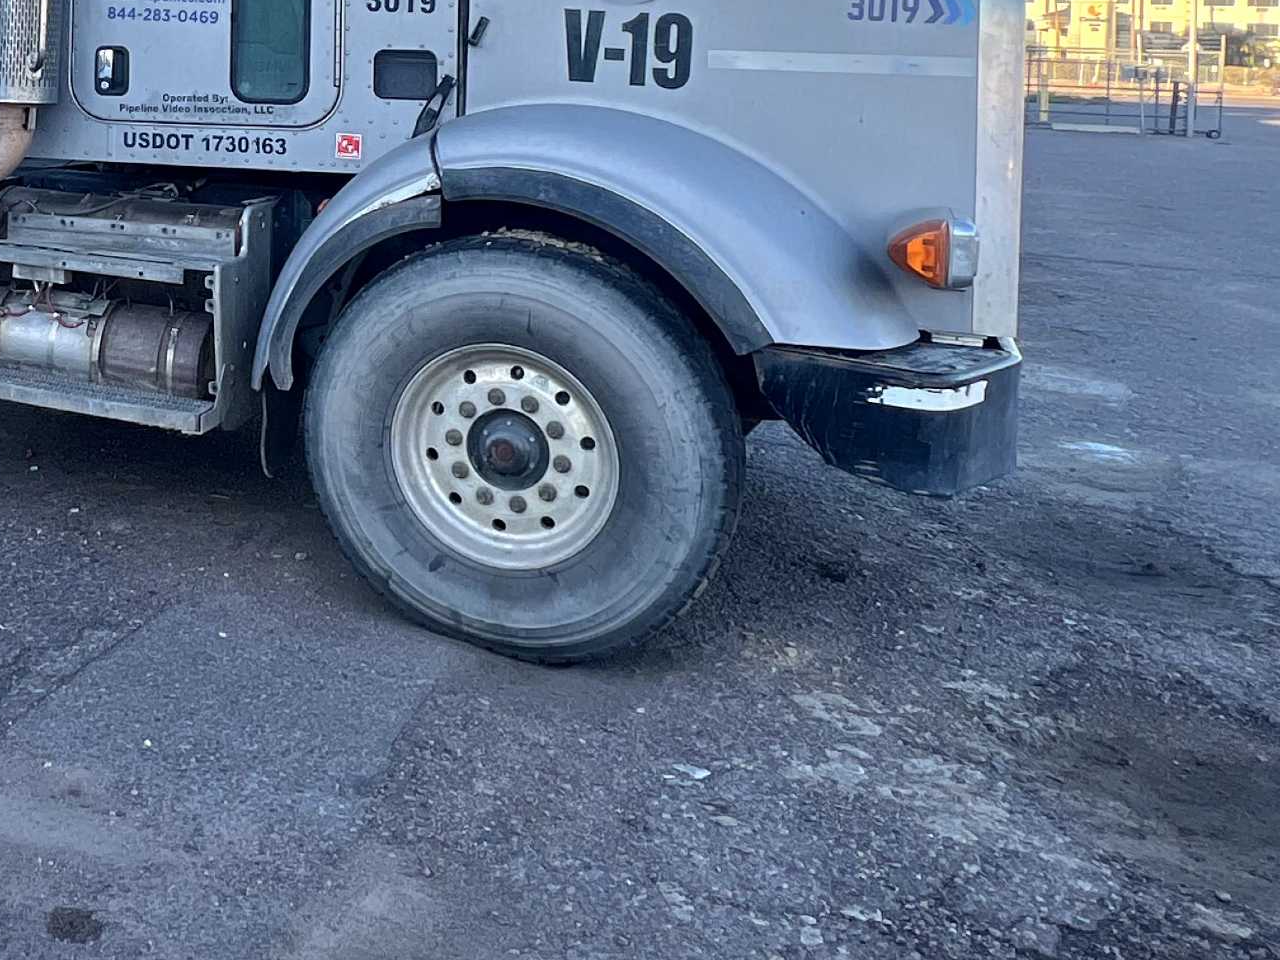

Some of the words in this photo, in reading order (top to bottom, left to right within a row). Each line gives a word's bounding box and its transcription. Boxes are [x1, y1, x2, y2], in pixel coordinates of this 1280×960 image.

[107, 6, 219, 24] 844-283-0469
[564, 8, 693, 89] V-19
[162, 93, 209, 103] Operated
[119, 103, 158, 113] Pipeline
[162, 104, 191, 113] Video
[254, 106, 274, 115] LLC
[123, 132, 194, 150] USDOT
[201, 135, 287, 155] 1730163
